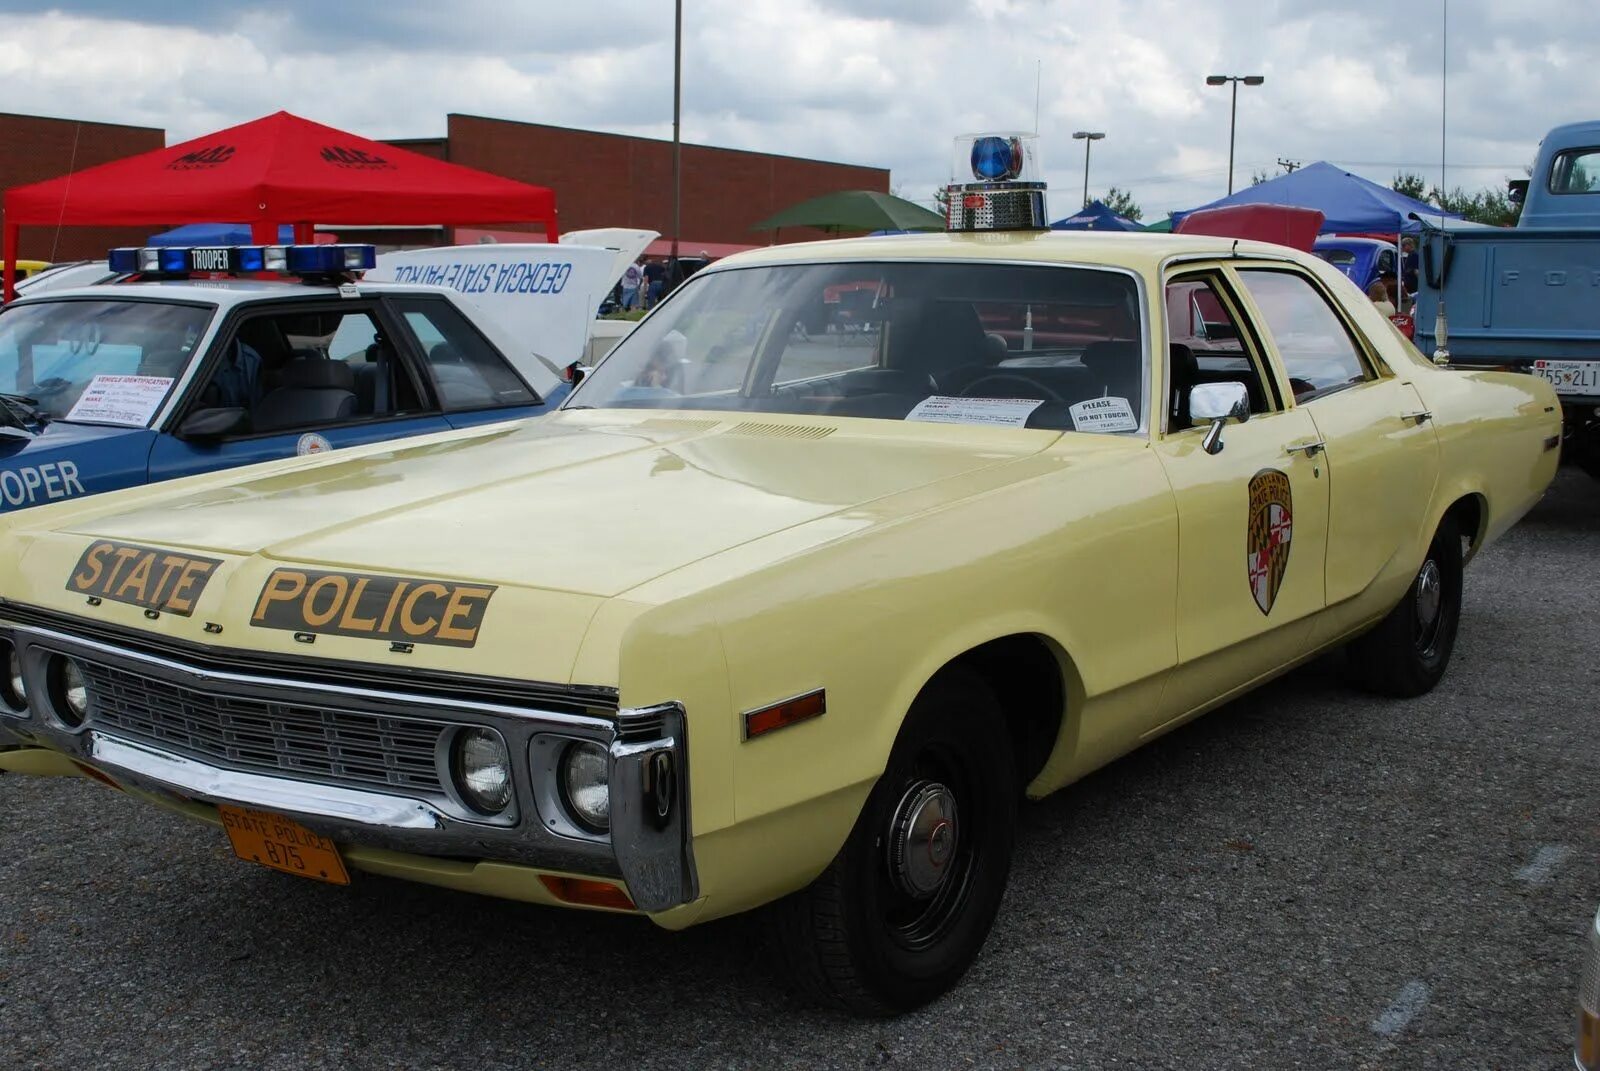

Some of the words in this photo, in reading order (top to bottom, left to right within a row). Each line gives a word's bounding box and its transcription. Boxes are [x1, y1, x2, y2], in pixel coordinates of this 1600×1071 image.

[191, 250, 229, 270] TROOPER
[447, 263, 497, 293] STATE
[494, 263, 572, 294] GEORGIA
[0, 460, 86, 506] OPER
[75, 543, 213, 611] STATE
[252, 570, 493, 641] POLICE
[222, 811, 272, 838] STATE
[274, 824, 330, 852] POLICE
